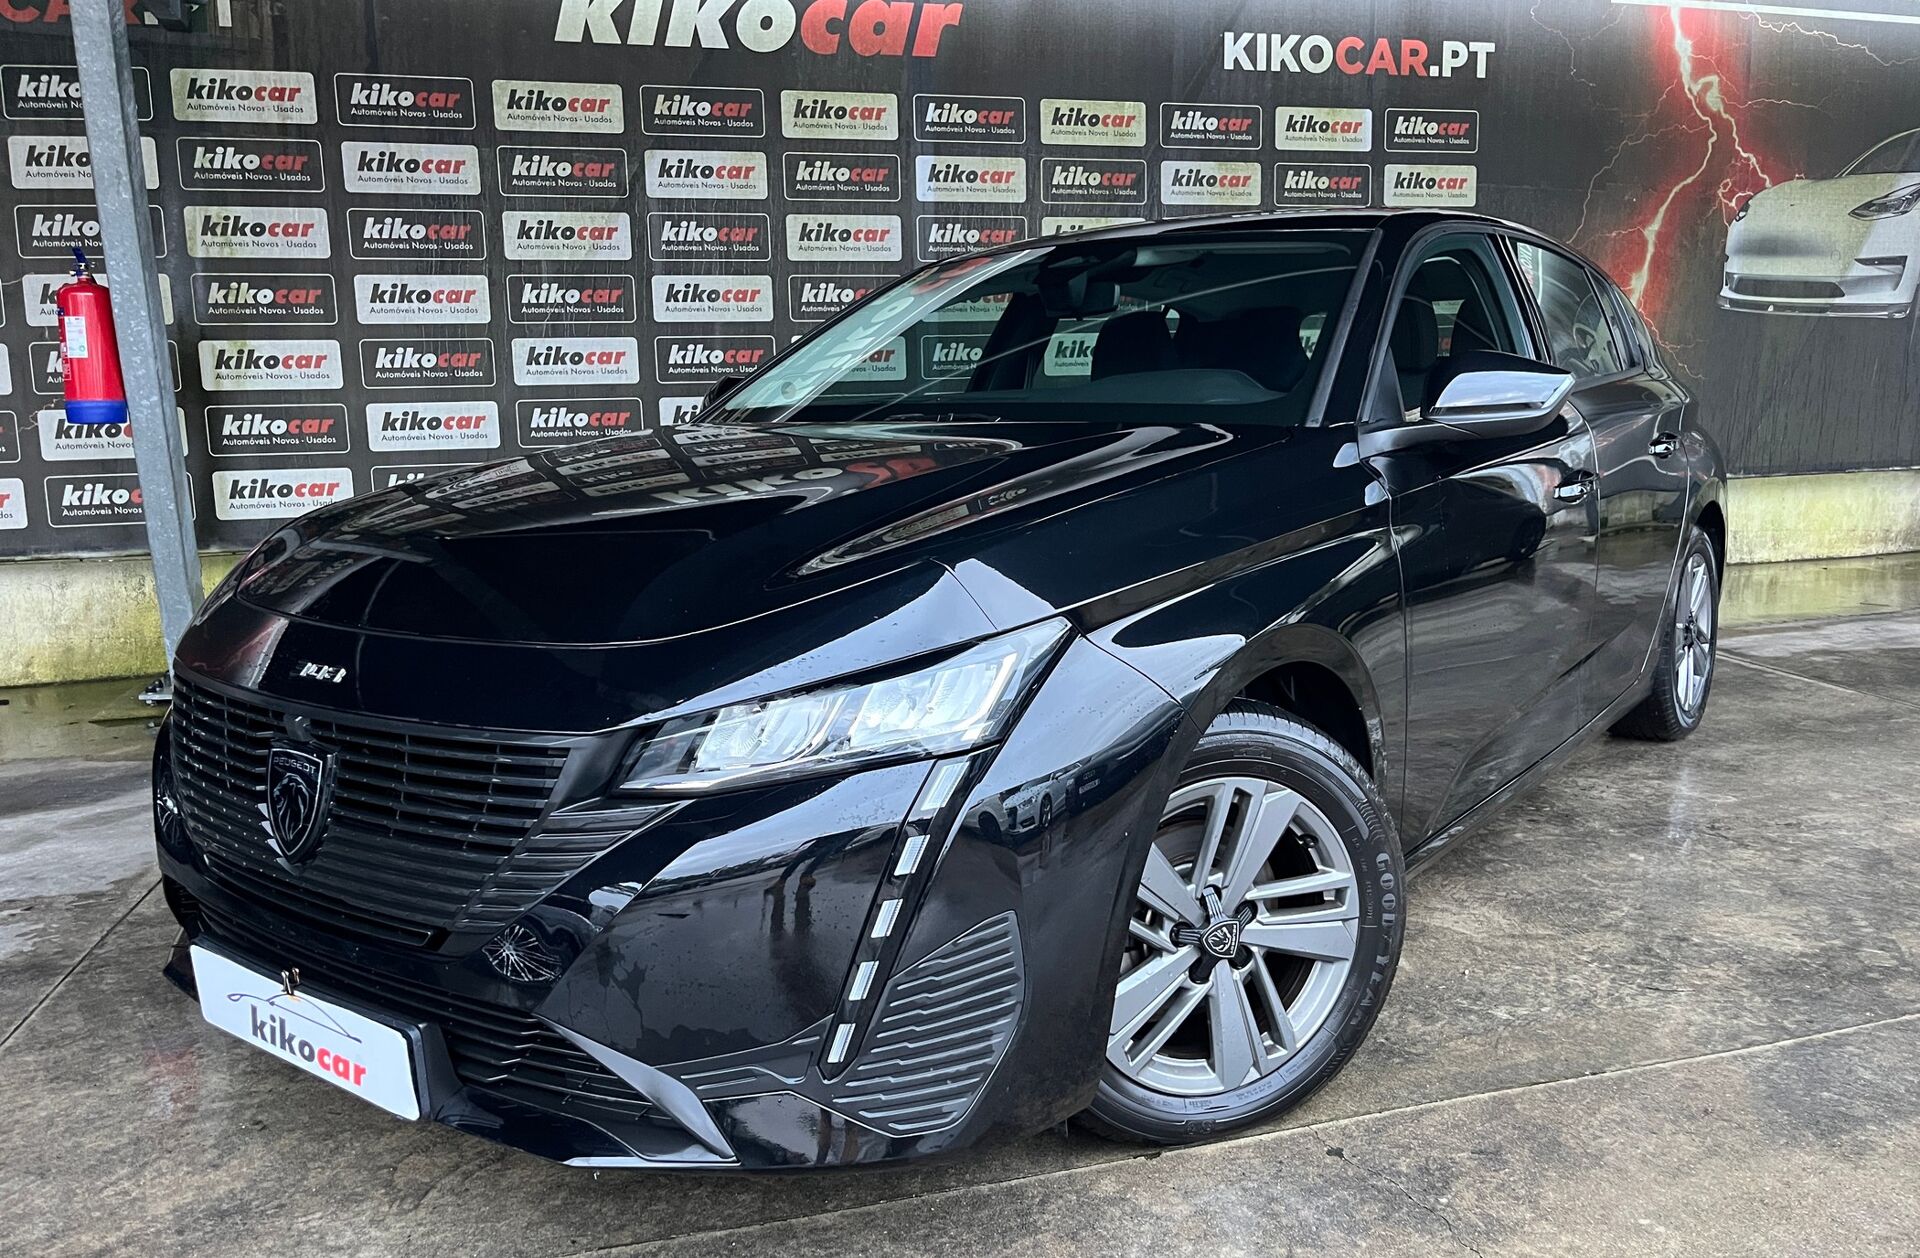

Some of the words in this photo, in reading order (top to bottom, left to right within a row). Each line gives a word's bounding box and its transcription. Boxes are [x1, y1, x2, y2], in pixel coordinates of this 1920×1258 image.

[554, 0, 963, 57] kikocar
[1223, 31, 1496, 79] KIKOCAR.PT
[17, 74, 81, 97] kiko
[186, 77, 301, 102] kikocar
[351, 82, 460, 107] kikocar
[17, 98, 67, 109] Automóveis
[186, 102, 236, 111] Automóveis
[238, 104, 265, 112] Novos
[272, 104, 304, 113] Usados
[507, 89, 610, 113] kikocar
[654, 94, 752, 117] kikocar
[793, 99, 887, 120] kikocar
[351, 107, 398, 116] Automóveis
[400, 109, 426, 117] Novos
[433, 110, 463, 119] Usados
[507, 113, 551, 121] Automóveis
[553, 114, 578, 122] Novos
[584, 115, 612, 123] Usados
[654, 118, 696, 126] Automóveis
[727, 119, 754, 127] Usados
[926, 103, 1014, 124] kikocar
[1051, 107, 1136, 128] kikocar
[1171, 111, 1252, 131] kikocar
[793, 121, 833, 129] Automóveis
[835, 122, 857, 130] Novos
[1285, 114, 1363, 134] kikocar
[1395, 116, 1469, 135] kikocar
[25, 144, 91, 167] kiko
[193, 146, 308, 170] kikocar
[357, 150, 466, 174] kikocar
[25, 169, 75, 178] Automóveis
[194, 171, 243, 180] Automóveis
[245, 172, 272, 180] Novos
[279, 173, 311, 181] Usados
[512, 155, 615, 177] kikocar
[658, 158, 755, 179] kikocar
[796, 161, 889, 182] kikocar
[927, 163, 1015, 184] kikocar
[1052, 166, 1136, 186] kikocar
[357, 175, 404, 183] Automóveis
[406, 176, 432, 184] Novos
[439, 176, 468, 185] Usados
[512, 178, 556, 186] Automóveis
[558, 179, 582, 187] Novos
[588, 179, 616, 187] Usados
[796, 183, 835, 191] Automóveis
[1171, 168, 1251, 188] kikocar
[1284, 170, 1362, 189] kikocar
[1393, 172, 1468, 190] kikocar
[32, 213, 100, 236] kiko
[200, 215, 314, 237] kikocar
[363, 217, 471, 239] kikocar
[517, 220, 618, 241] kikocar
[661, 221, 758, 242] kikocar
[798, 222, 890, 242] kikocar
[929, 223, 1017, 244] kikocar
[32, 238, 82, 248] Automóveis
[84, 239, 104, 247] Nov
[201, 239, 250, 247] Automóveis
[252, 240, 279, 248] Novos
[286, 240, 317, 248] Usados
[363, 241, 410, 249] Automóveis
[444, 242, 473, 250] Usados
[733, 243, 759, 251] Usados
[866, 244, 891, 252] Usados
[208, 282, 321, 304] kikocar
[370, 283, 476, 304] kikocar
[521, 283, 622, 304] kikocar
[665, 283, 761, 303] kikocar
[801, 283, 874, 303] kikoc
[293, 306, 324, 314] Usados
[418, 306, 443, 314] Novos
[449, 306, 478, 314] Usados
[597, 305, 624, 313] Usados
[736, 304, 762, 312] Usados
[215, 349, 327, 370] kikocar
[375, 347, 481, 368] kikocar
[526, 346, 626, 366] kikocar
[669, 344, 764, 364] kikocar
[932, 342, 983, 362] kiko
[266, 372, 292, 380] Novos
[299, 371, 330, 379] Usados
[423, 370, 448, 378] Novos
[454, 369, 483, 377] Usados
[600, 367, 628, 375] Usados
[740, 365, 758, 373] Usad
[222, 414, 334, 435] kikocar
[381, 411, 486, 432] kikocar
[531, 408, 630, 428] kikocar
[55, 418, 133, 439] kiko
[460, 431, 488, 439] Usados
[55, 442, 105, 450] Automóveis
[306, 435, 336, 444] Usados
[62, 484, 143, 506] kikoc
[230, 478, 340, 500] kikocar
[62, 507, 112, 517] Automóveis
[114, 506, 143, 514] Novos
[273, 757, 317, 774] PEUGEOT
[250, 1003, 367, 1087] kikocar
